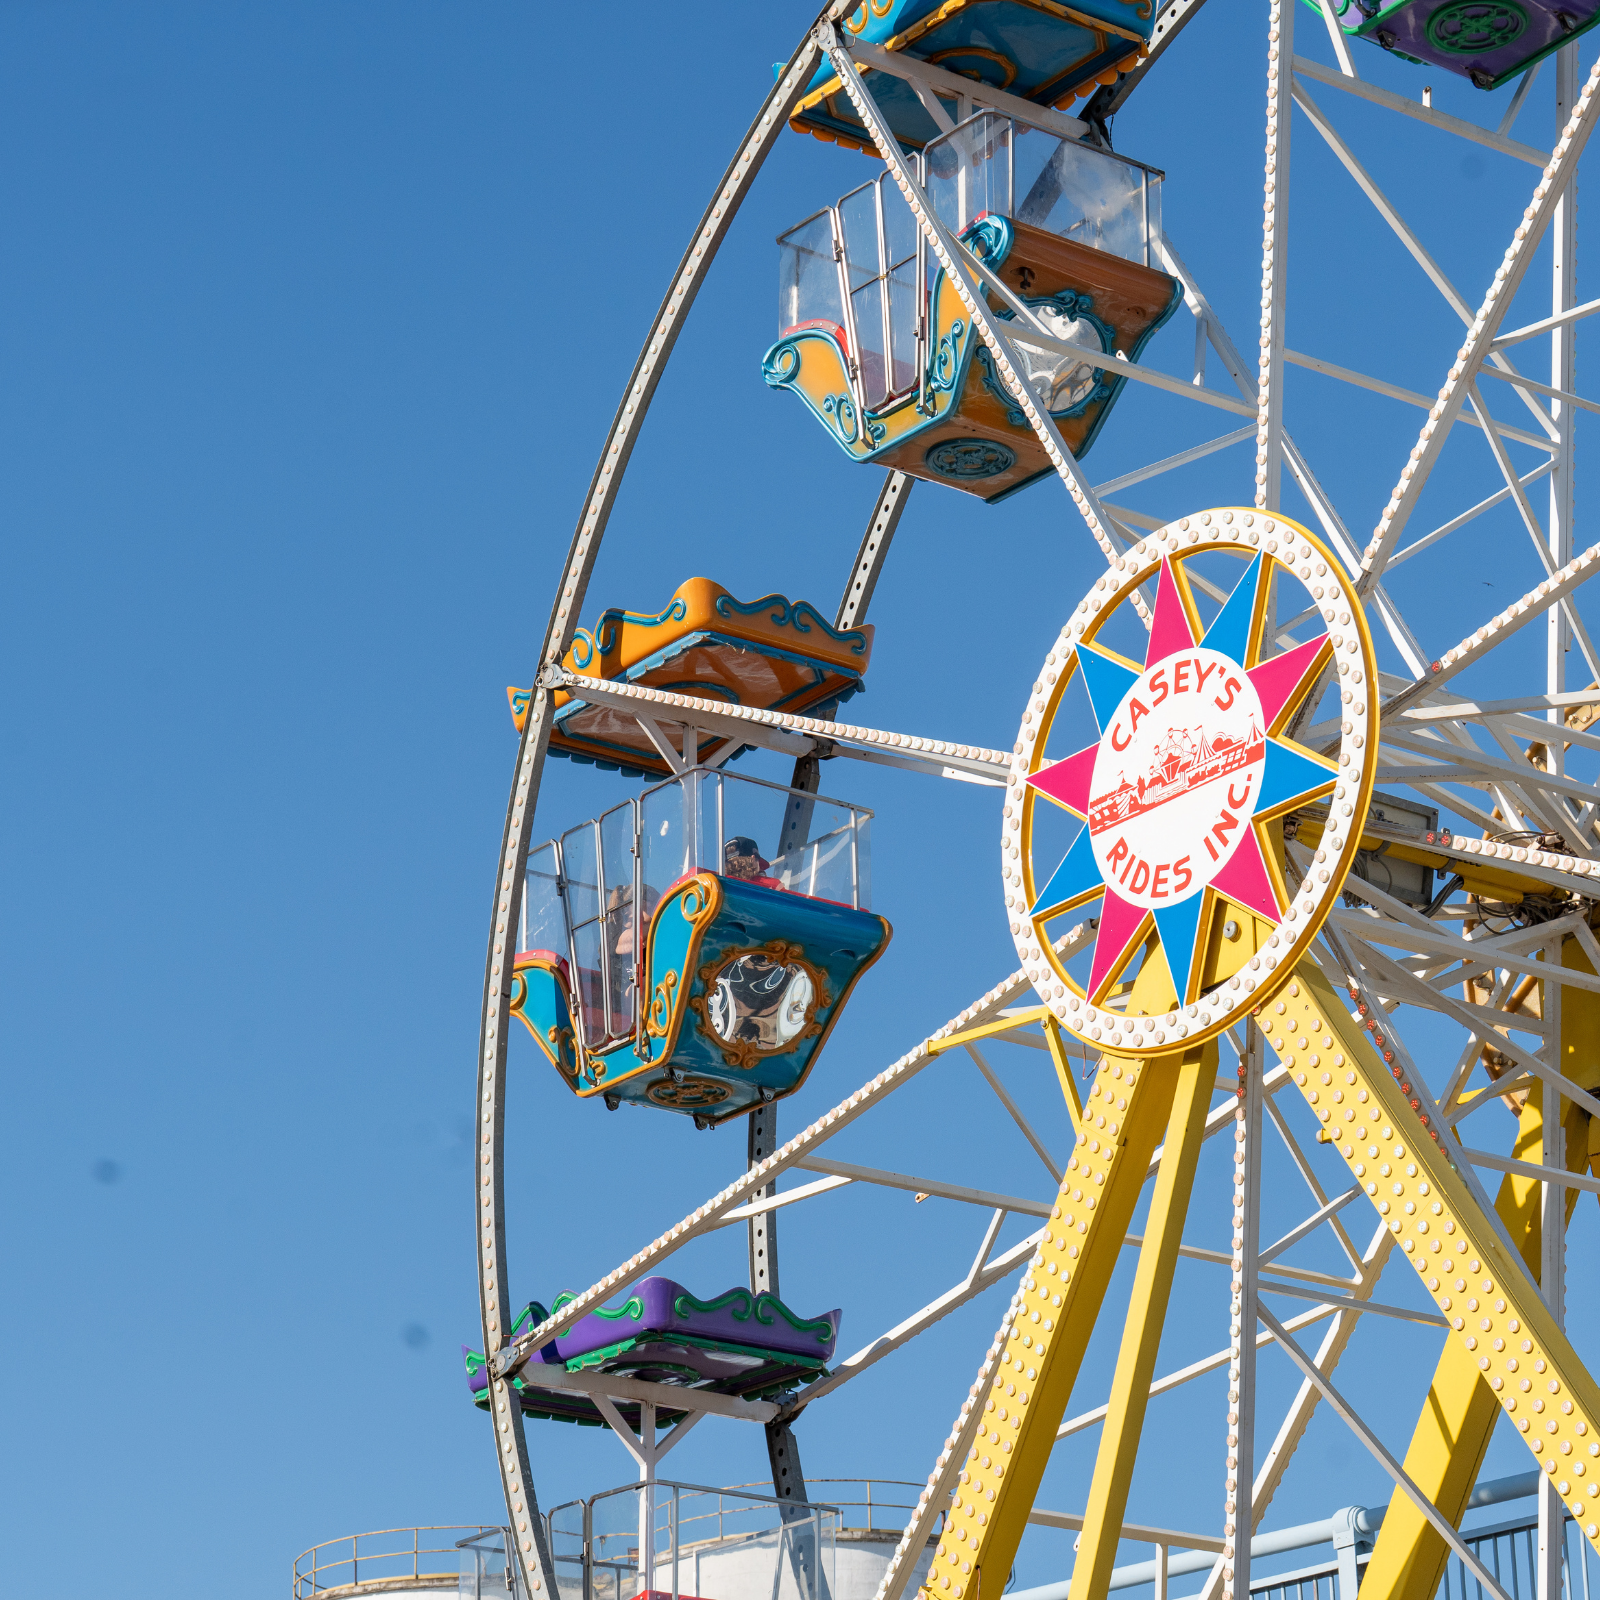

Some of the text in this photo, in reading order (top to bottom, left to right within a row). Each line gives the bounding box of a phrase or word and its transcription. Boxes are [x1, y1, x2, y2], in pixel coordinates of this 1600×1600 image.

[1111, 658, 1243, 752] CASEY'S
[1105, 773, 1253, 898] RIDES INC.
